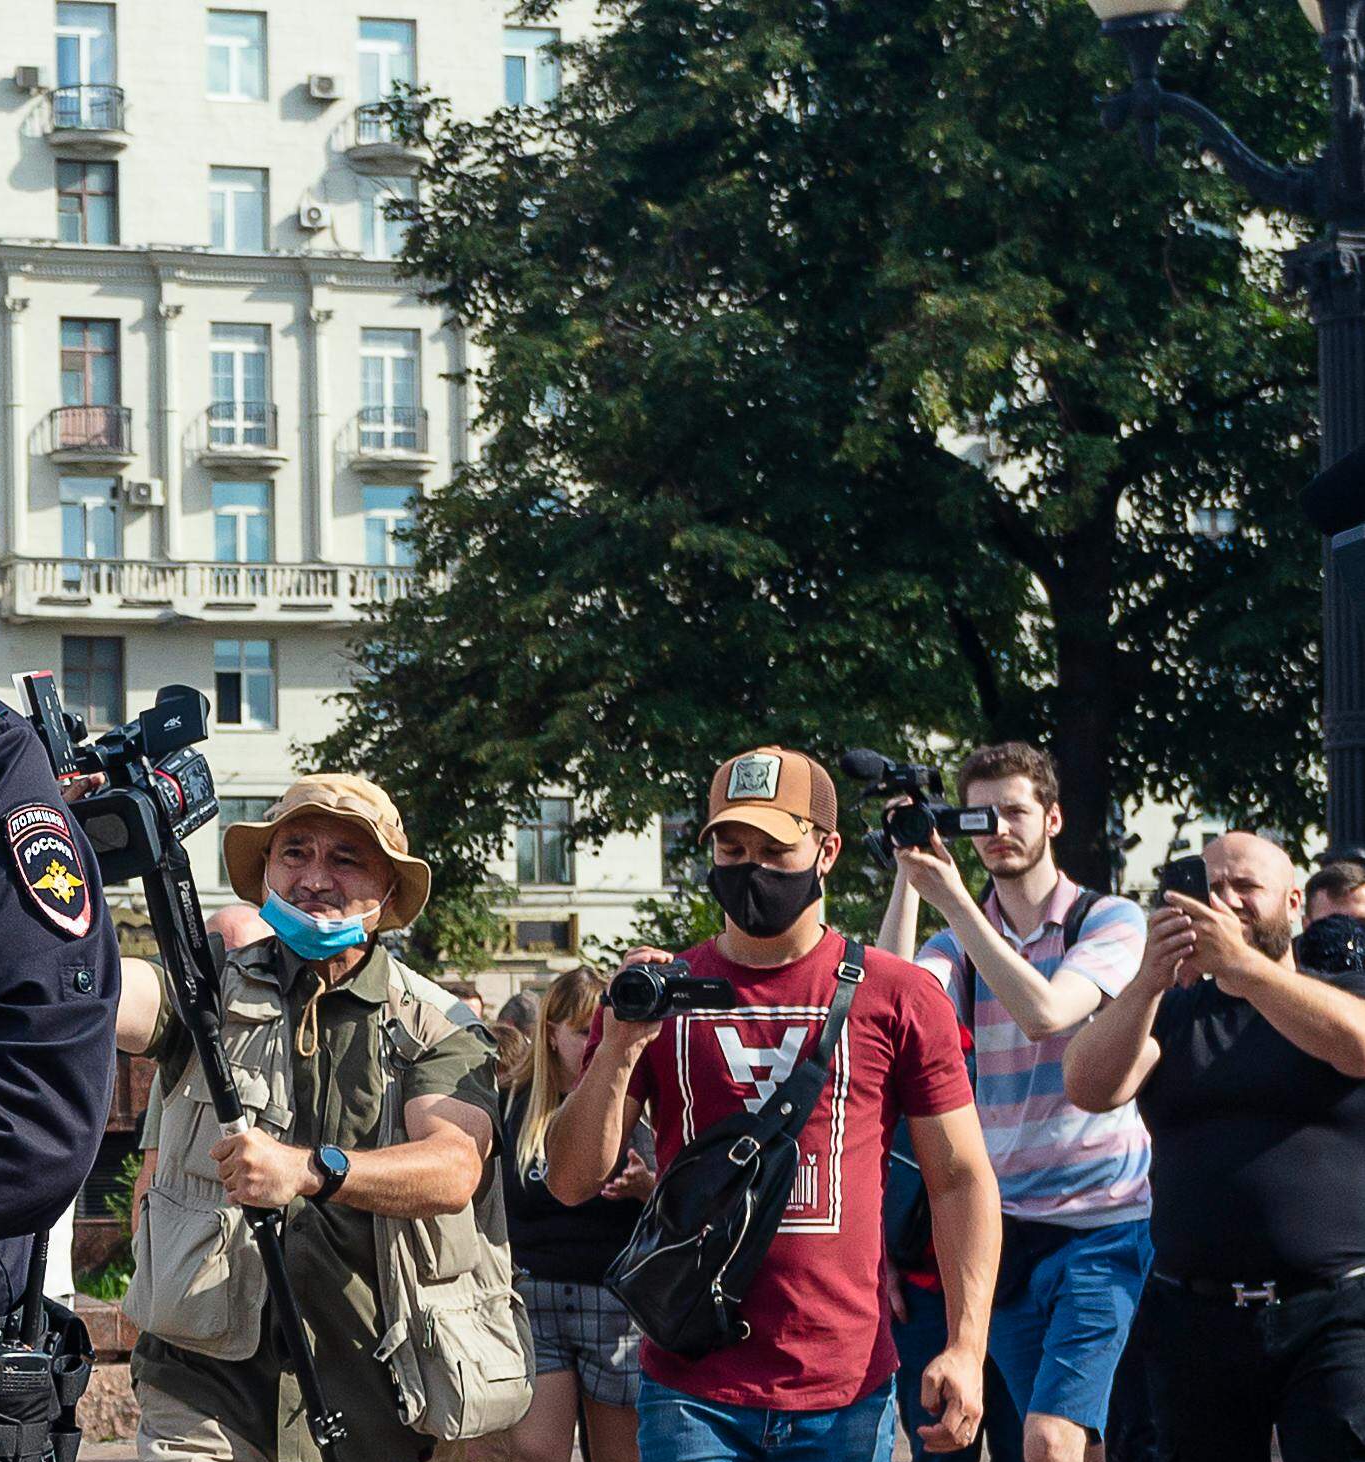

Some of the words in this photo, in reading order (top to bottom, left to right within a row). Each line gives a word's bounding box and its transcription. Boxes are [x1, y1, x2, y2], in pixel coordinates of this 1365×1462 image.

[11, 810, 65, 833] ПОЛИЦИЯ
[23, 837, 74, 864] РОССИЯ
[178, 880, 203, 949] Panasonic
